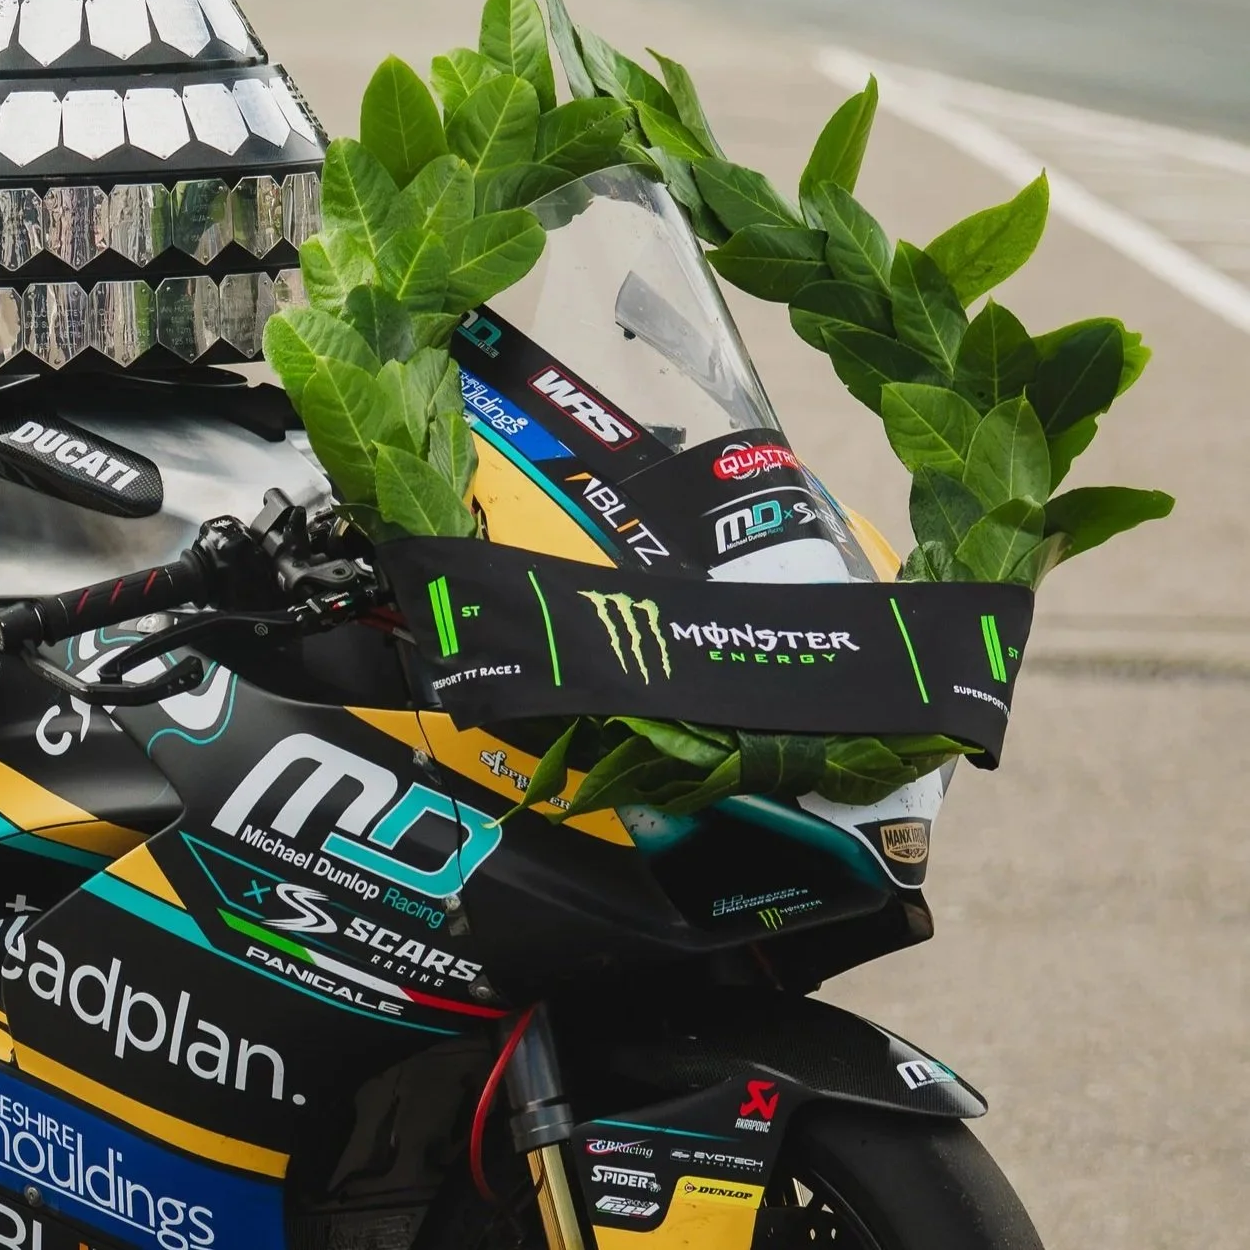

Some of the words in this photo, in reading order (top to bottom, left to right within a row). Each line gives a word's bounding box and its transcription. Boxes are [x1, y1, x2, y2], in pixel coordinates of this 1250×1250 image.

[532, 368, 634, 444] WRS
[9, 421, 140, 491] DUCATI
[726, 538, 748, 551] Michael
[748, 530, 767, 543] Dunlop
[668, 621, 860, 652] MONSTER
[710, 651, 836, 664] ENERGY
[464, 668, 477, 680] TT
[479, 665, 513, 677] RACE
[514, 664, 521, 674] 2
[953, 685, 1005, 711] SUPERSPORT
[211, 733, 502, 899] MD
[884, 829, 912, 850] MANX
[239, 824, 312, 869] Michael
[313, 858, 380, 901] Dunlop
[382, 887, 445, 929] Racing
[343, 917, 483, 982] SCARS
[246, 946, 404, 1016] PANIGALE
[370, 954, 445, 987] RACING
[693, 1151, 763, 1168] EVOTECH
[591, 1165, 651, 1189] SPIDER
[698, 1186, 753, 1200] DUNLOP
